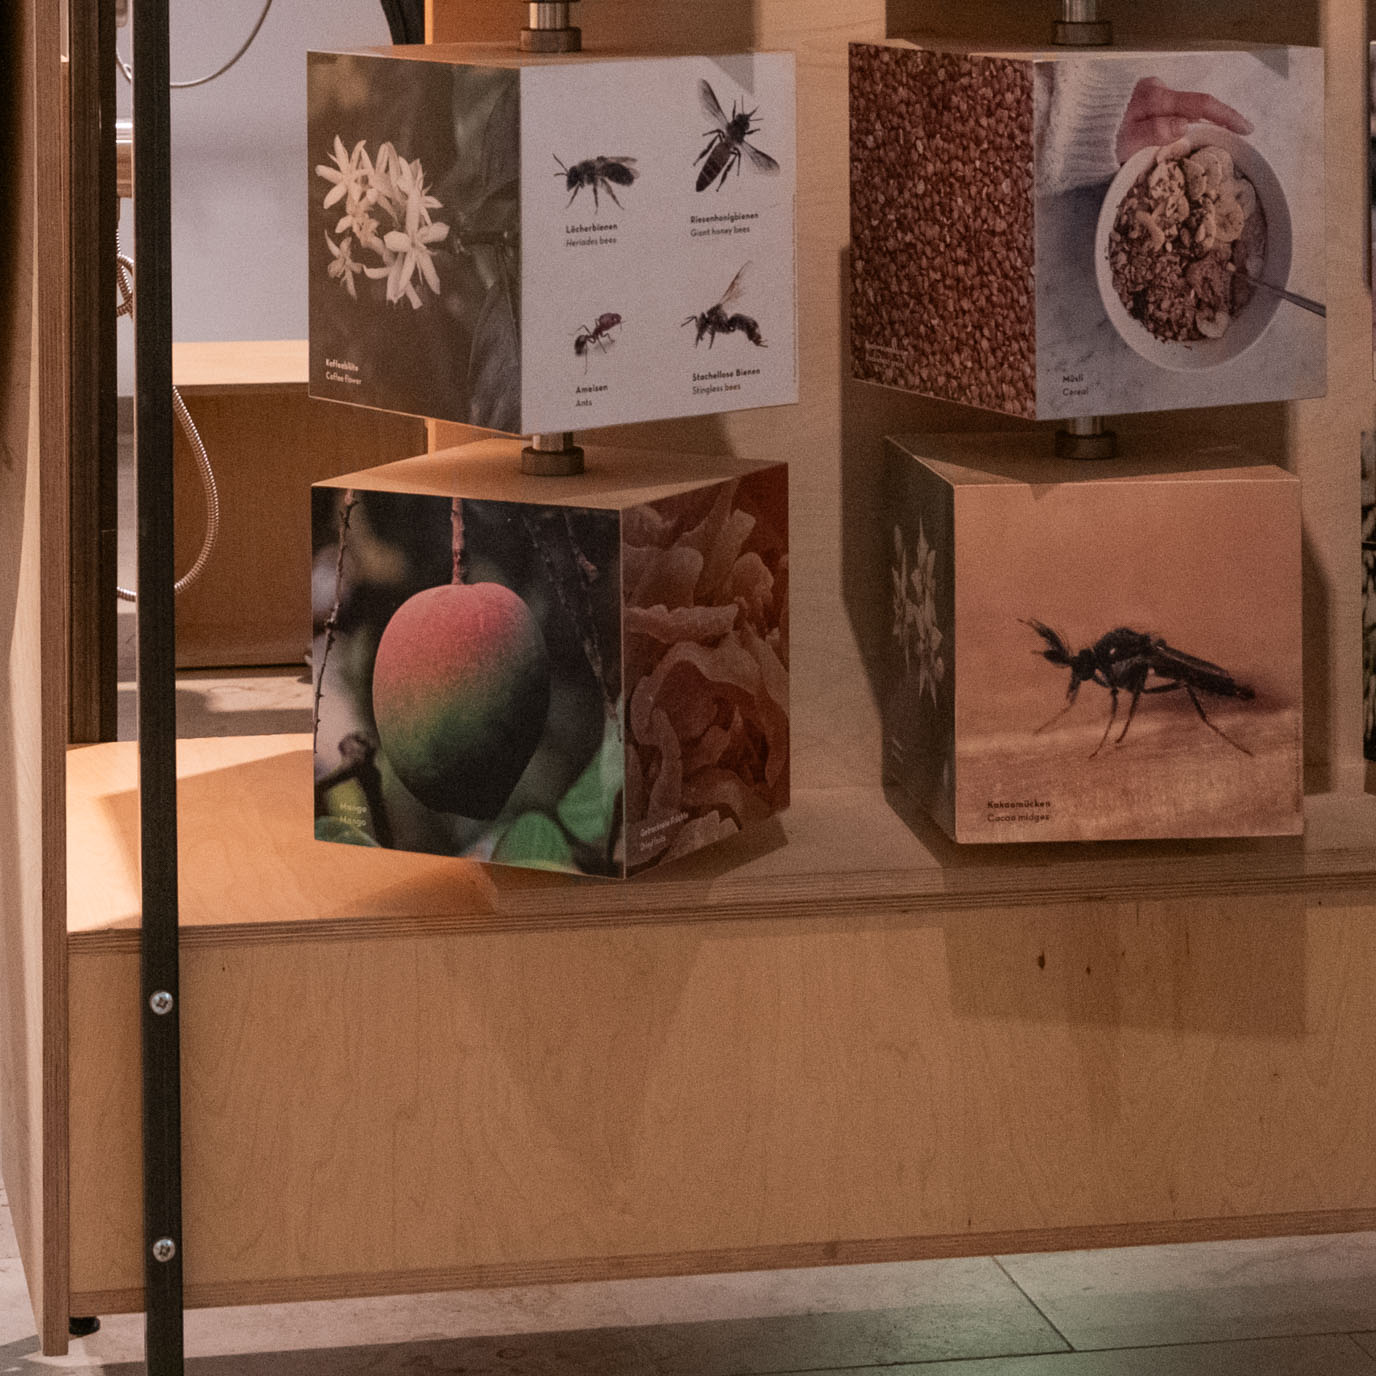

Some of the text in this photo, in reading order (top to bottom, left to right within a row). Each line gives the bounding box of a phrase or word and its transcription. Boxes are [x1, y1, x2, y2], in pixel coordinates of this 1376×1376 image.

[690, 212, 759, 224] Riesenhonigbienen
[566, 223, 618, 233] Löcherbienen
[690, 229, 711, 237] Giant
[711, 227, 733, 235] honey
[692, 371, 734, 381] Stachellose
[575, 385, 609, 393] Ameisen
[692, 385, 724, 395] Stingless
